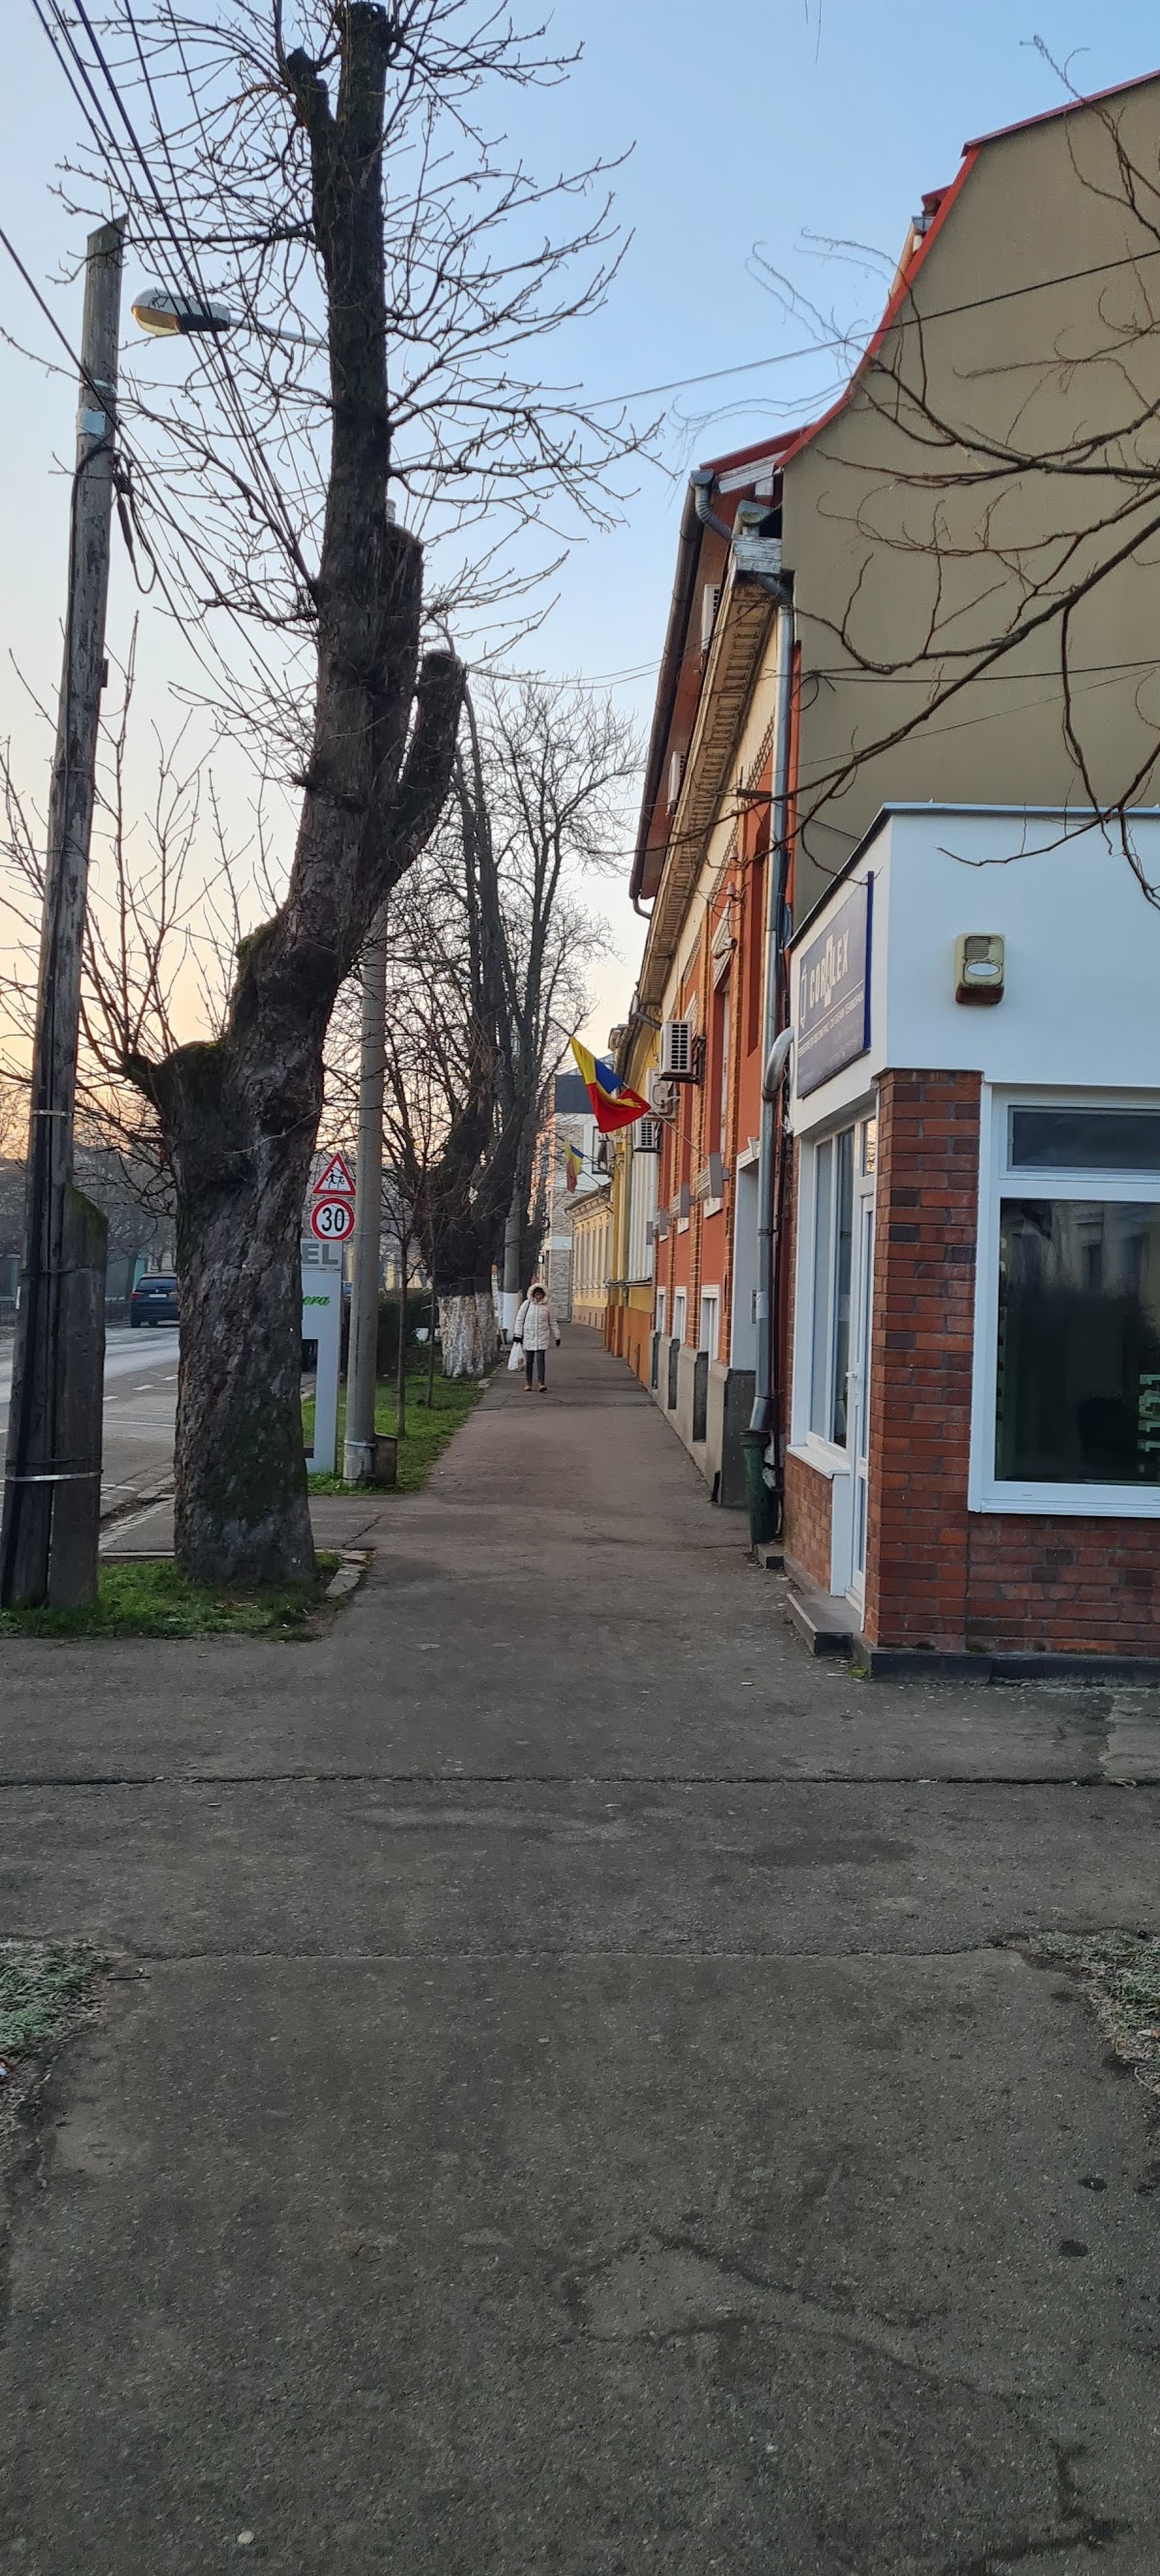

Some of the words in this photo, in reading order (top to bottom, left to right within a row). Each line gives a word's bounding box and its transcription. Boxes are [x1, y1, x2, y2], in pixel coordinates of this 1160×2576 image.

[809, 929, 850, 1009] CORALEX
[322, 1207, 345, 1231] 30
[302, 1244, 338, 1265] EL
